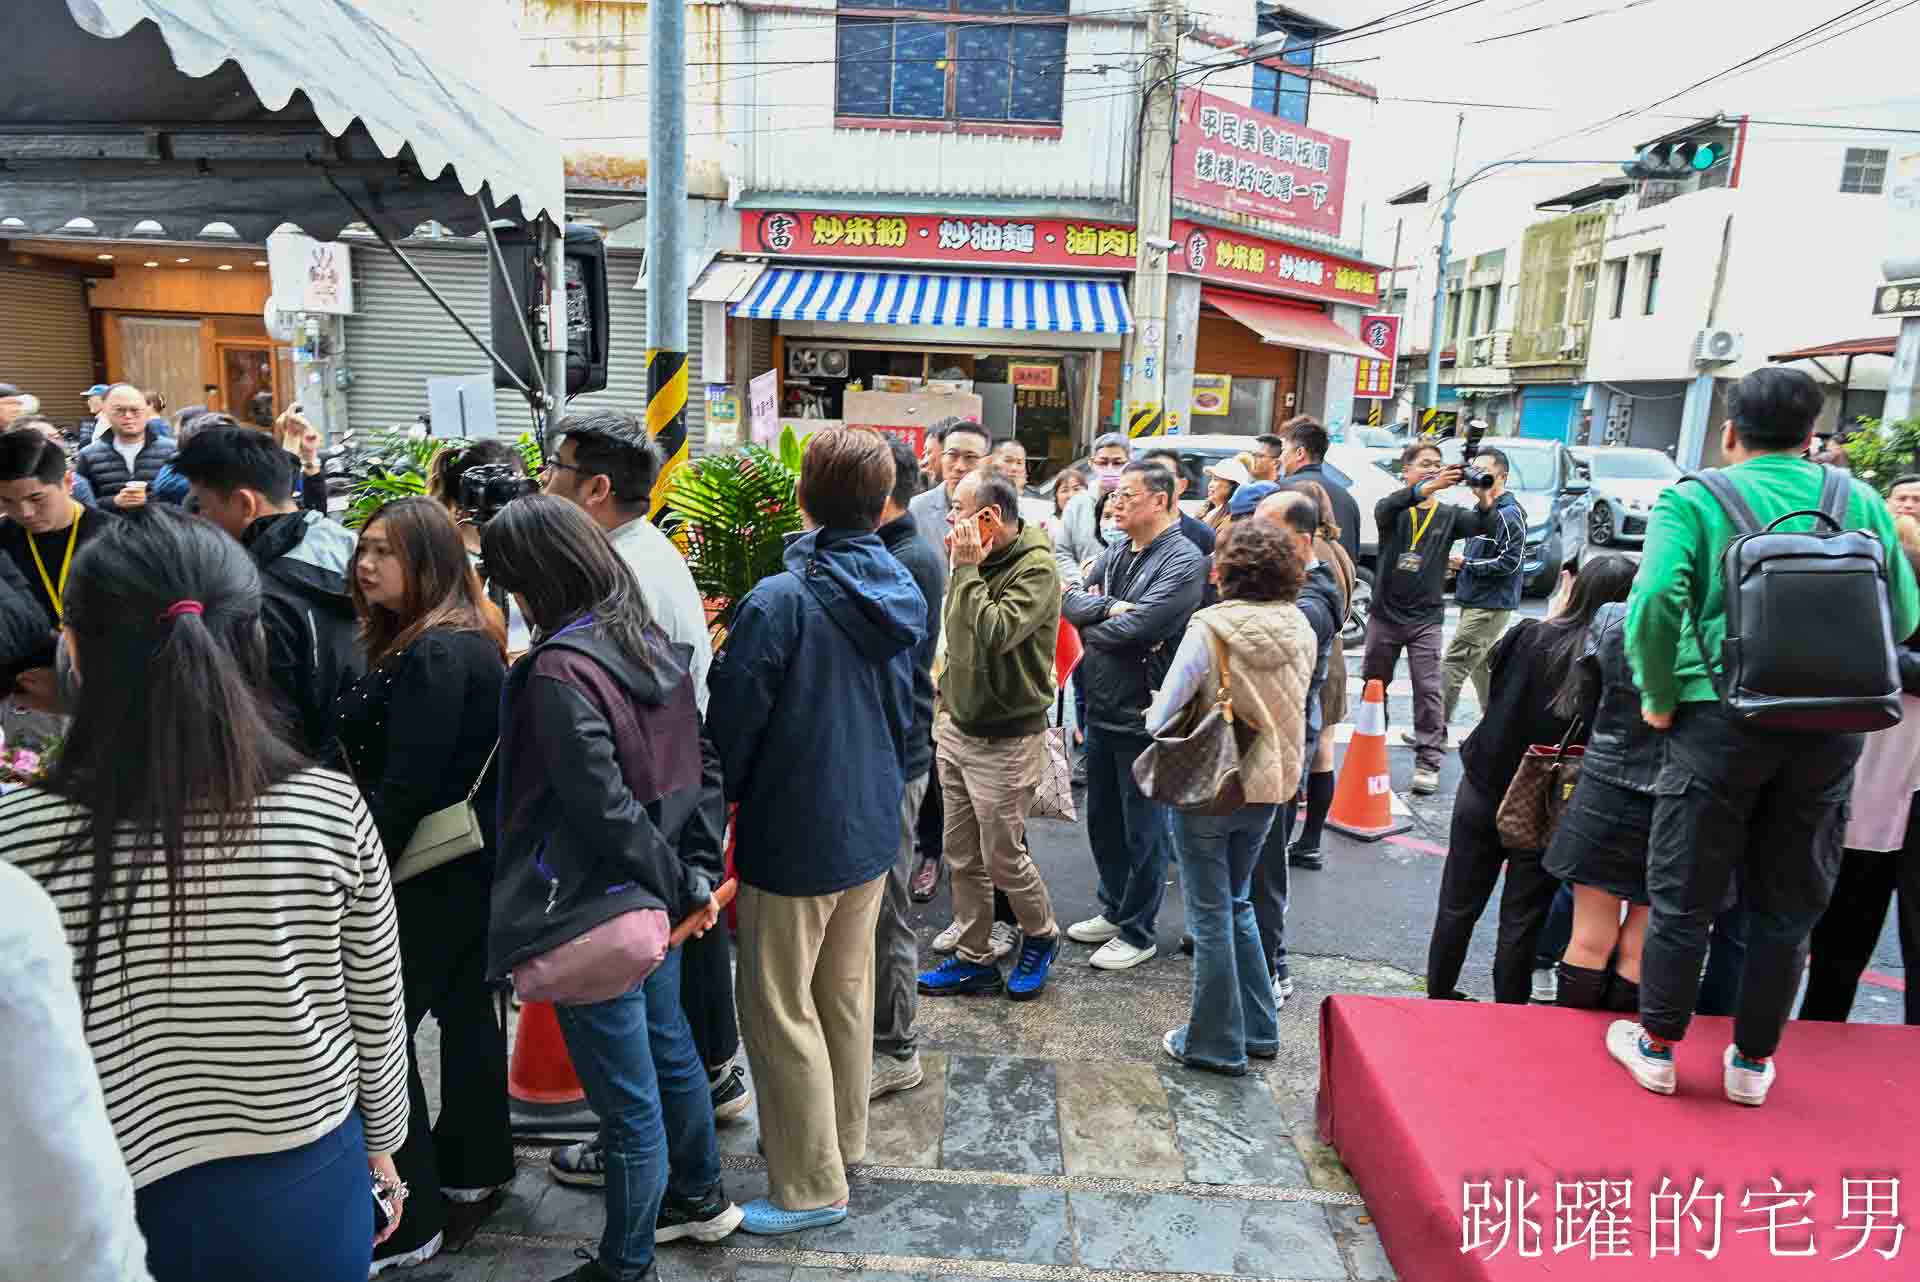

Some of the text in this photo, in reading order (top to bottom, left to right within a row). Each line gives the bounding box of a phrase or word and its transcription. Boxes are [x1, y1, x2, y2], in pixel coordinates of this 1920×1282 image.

[768, 214, 794, 250] 富
[812, 215, 908, 248] 炒米粉
[938, 220, 1034, 253] 炒油麵
